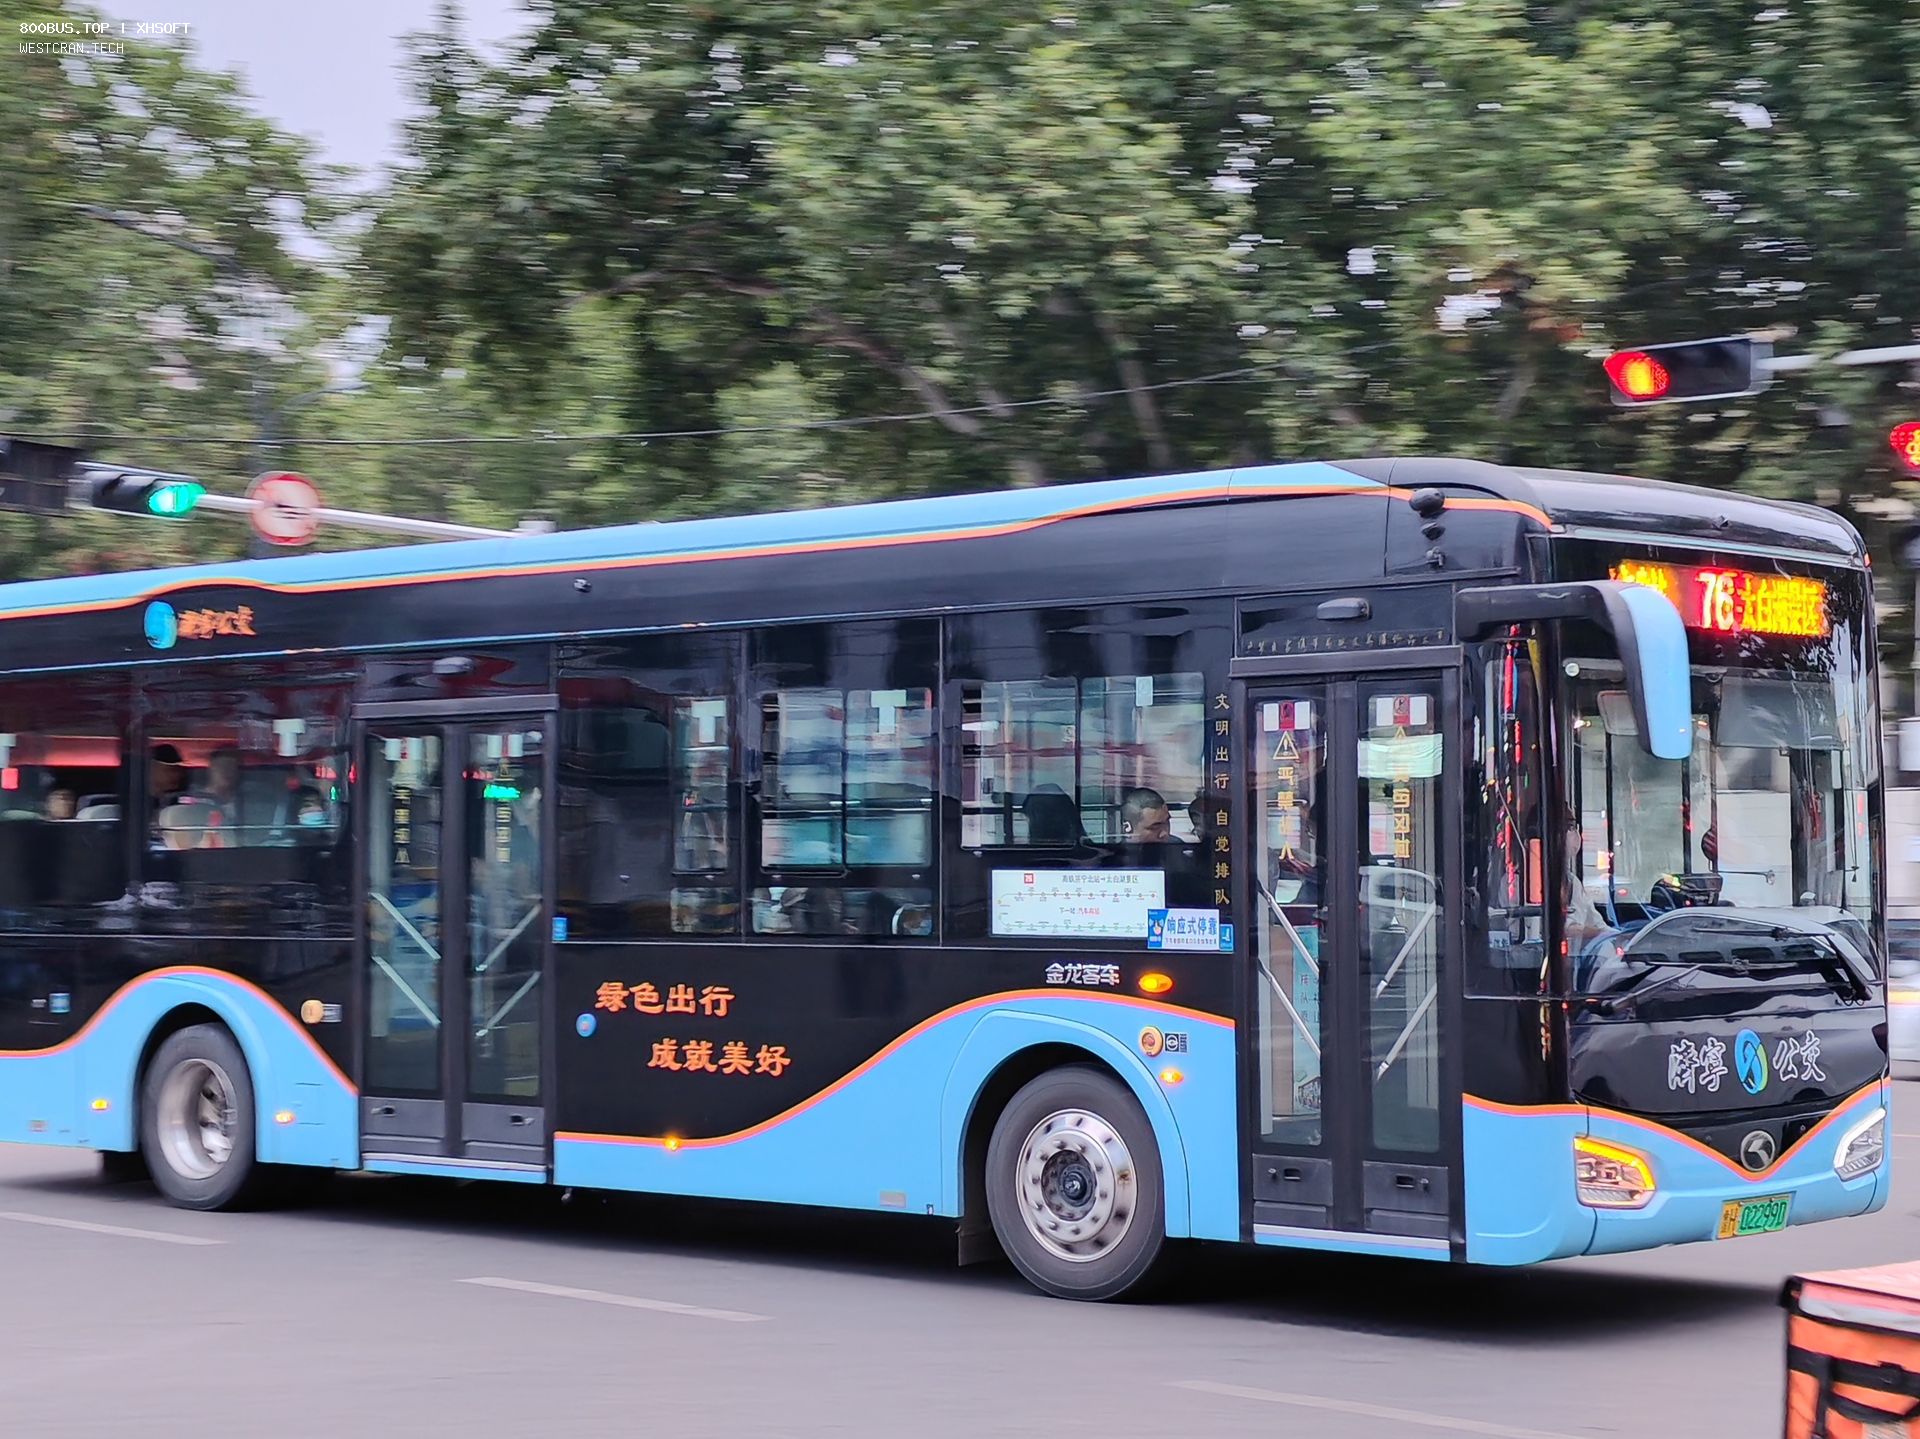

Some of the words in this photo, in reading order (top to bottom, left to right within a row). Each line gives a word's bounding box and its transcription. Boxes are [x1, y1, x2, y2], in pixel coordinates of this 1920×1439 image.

[1696, 571, 1735, 631] 76
[1213, 693, 1231, 790] 文明出行
[1214, 808, 1231, 905] 自觉排队
[1167, 916, 1217, 935] 响应式停靠
[1045, 962, 1121, 986] 金龙客车
[594, 981, 736, 1017] 绿色出行
[647, 1037, 792, 1077] 成就美好
[1772, 1030, 1827, 1082] 公交
